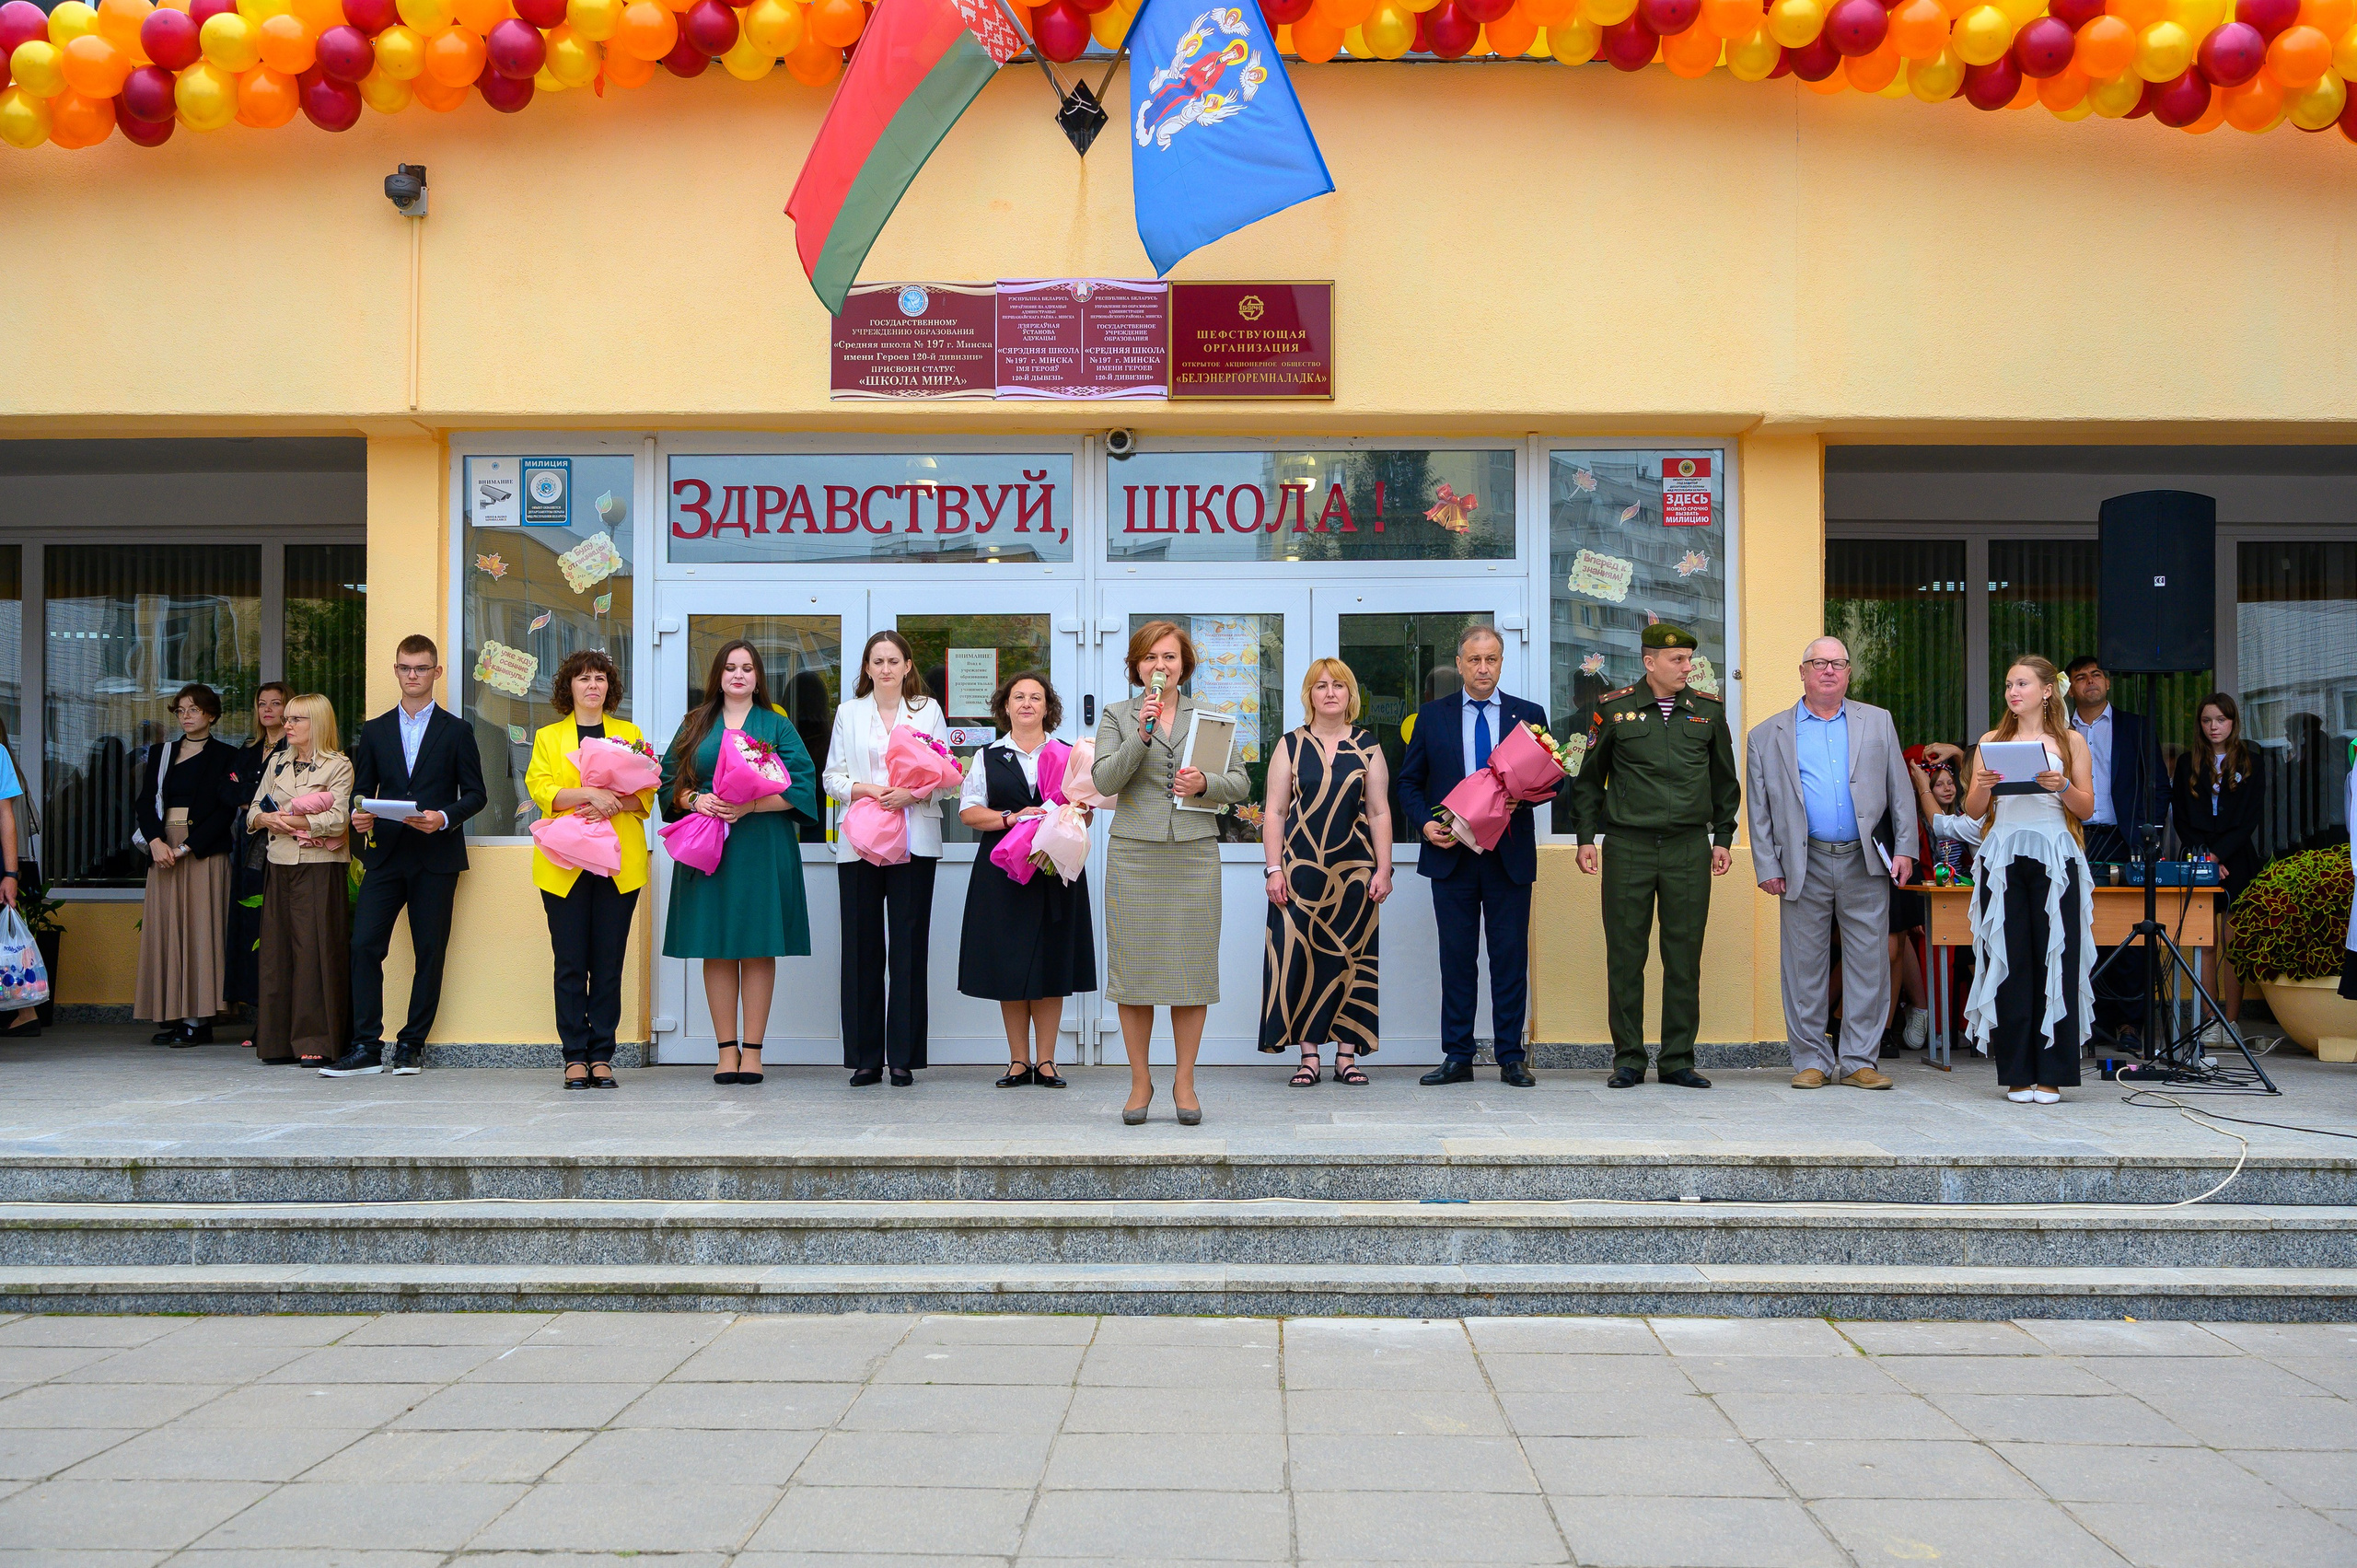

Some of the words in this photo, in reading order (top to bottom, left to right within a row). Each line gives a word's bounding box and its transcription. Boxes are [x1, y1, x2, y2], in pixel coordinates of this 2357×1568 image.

[1197, 330, 1306, 340] ШЕФСТВУЮЩАЯ
[834, 340, 878, 349] «Средняя
[927, 340, 944, 348] 197
[1203, 344, 1299, 354] ОРГАНИЗАЦИЯ
[877, 353, 909, 361] Героев
[859, 376, 918, 385] «ШКОЛА
[922, 376, 967, 385] МИРА»
[1176, 373, 1327, 384] «БЕЛЭНЕРГОРЕМНАЛАДКА»
[672, 469, 1069, 544] ЗДРАВСТВУЙ,
[1666, 494, 1708, 506] ЗДЕСЬ
[574, 542, 593, 556] Буду
[1584, 553, 1619, 571] Вперёд
[1582, 565, 1623, 581] знаниям!
[501, 650, 516, 659] уже
[517, 656, 533, 667] жду
[500, 659, 529, 673] осенние
[1687, 669, 1706, 683] олу!
